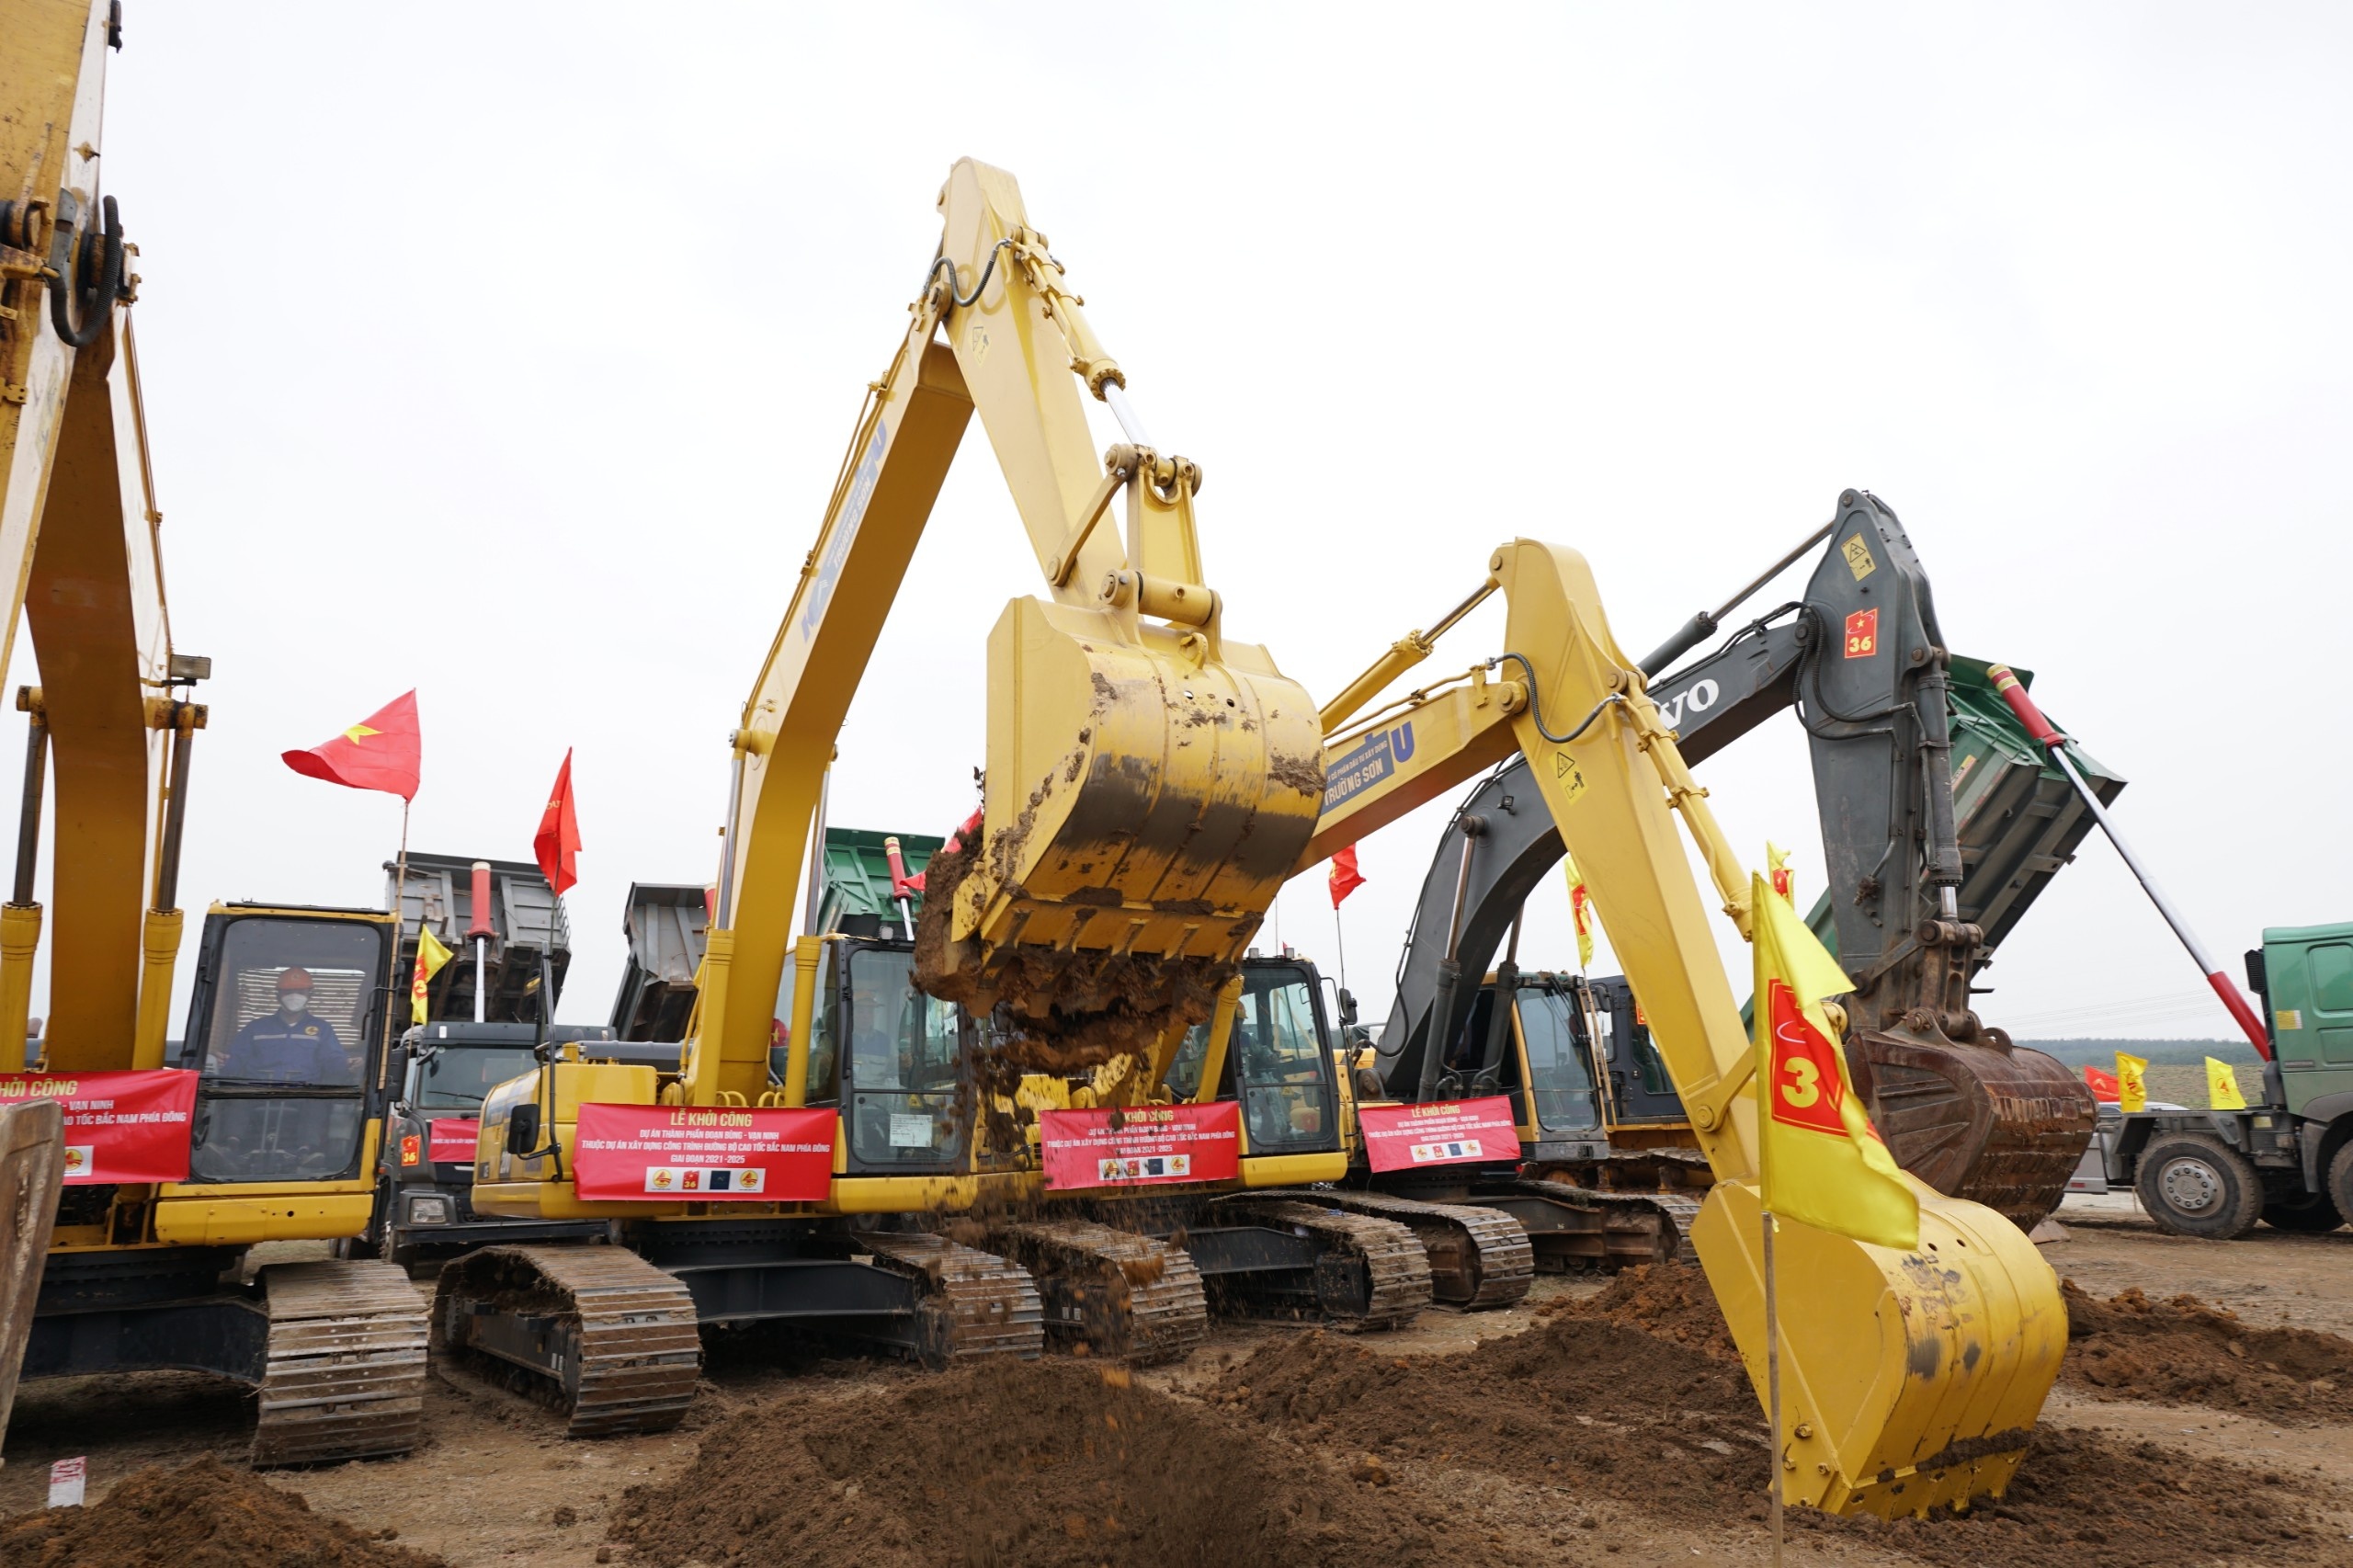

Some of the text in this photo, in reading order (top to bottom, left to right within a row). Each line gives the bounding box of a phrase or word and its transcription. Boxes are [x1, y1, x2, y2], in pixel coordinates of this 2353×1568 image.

[1848, 635, 1872, 653] 36
[1658, 678, 1720, 731] VO
[1361, 757, 1384, 782] SƠN
[0, 1076, 78, 1097] HỞI CÔNG
[69, 1100, 89, 1112] VẠN
[89, 1099, 115, 1110] NINH
[63, 1110, 188, 1126] AO TỐC BẮC NAM PHÍA ĐÔNG
[670, 1108, 753, 1128] LỄ KHỞI CÔNG
[1124, 1108, 1146, 1123] KHỞI
[650, 1129, 661, 1138] ÁN
[617, 1140, 627, 1150] ÁN
[628, 1140, 642, 1150] XÂY
[663, 1141, 682, 1151] CÔNG
[738, 1142, 752, 1152] CAO
[753, 1141, 766, 1152] TỐC
[767, 1141, 780, 1153] BẮC
[780, 1143, 796, 1153] NAM
[403, 1152, 416, 1163] 36
[670, 1154, 685, 1163] GIAI
[705, 1154, 723, 1164] 2021
